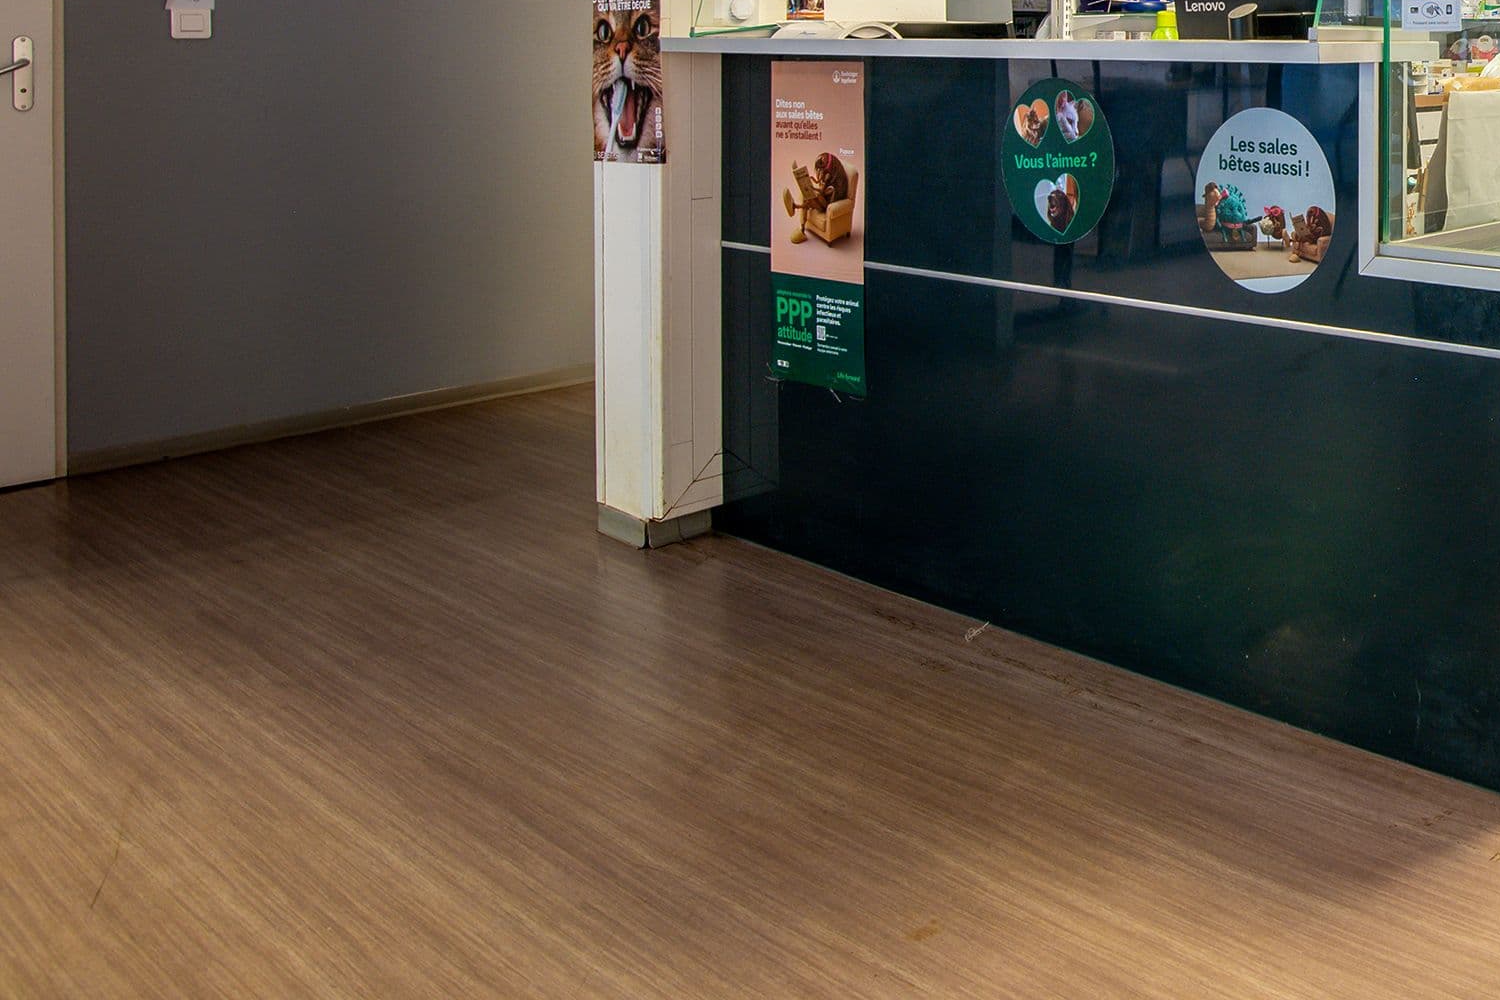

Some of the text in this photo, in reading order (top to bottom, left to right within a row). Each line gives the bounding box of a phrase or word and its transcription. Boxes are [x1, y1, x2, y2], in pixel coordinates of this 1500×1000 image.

[598, 2, 609, 12] QUI
[609, 2, 616, 11] VA
[1185, 0, 1226, 12] Lenovo
[775, 98, 806, 109] Dites non
[775, 110, 824, 121] aux sales bêtes
[775, 120, 818, 132] avant qu'elles
[775, 131, 784, 140] ne
[784, 130, 819, 141] s'installent
[1230, 136, 1298, 157] Les sales
[1014, 151, 1098, 170] Vous l'aimez ?
[1218, 153, 1310, 178] bêtes aussi !
[776, 296, 813, 327] PPP
[777, 326, 813, 343] attitude
